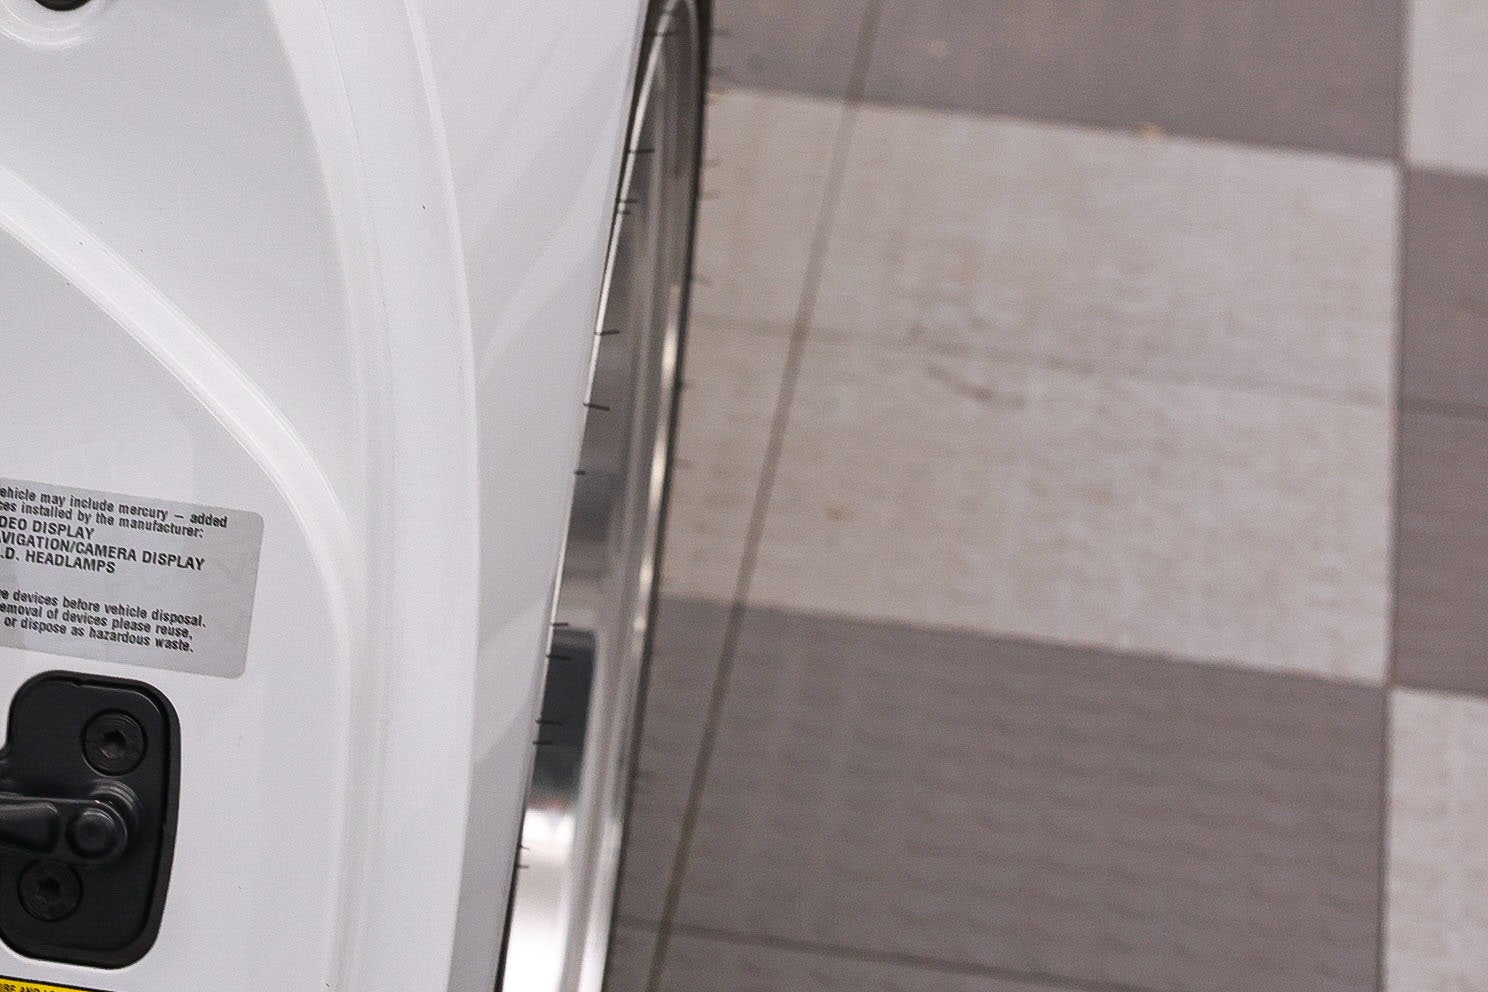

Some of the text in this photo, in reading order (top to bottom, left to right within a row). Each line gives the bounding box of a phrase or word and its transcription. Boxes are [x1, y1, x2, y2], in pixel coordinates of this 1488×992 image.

[21, 502, 72, 520] installed
[77, 509, 92, 524] by
[96, 512, 114, 526] the
[119, 517, 204, 538] manufacturer:
[40, 493, 66, 508] may
[70, 494, 114, 512] include
[119, 503, 168, 521] mercury
[190, 512, 228, 528] added
[33, 520, 94, 540] DISPLAY
[26, 549, 116, 573] HEADLAMPS
[142, 550, 205, 571] DISPLAY
[13, 589, 58, 606] devices
[63, 596, 100, 612] before
[104, 604, 147, 619] vehicle
[152, 608, 206, 627] disposal.
[47, 608, 59, 620] of
[62, 610, 107, 627] devices
[112, 617, 151, 633] please
[155, 624, 193, 640] reuse,
[4, 616, 17, 627] or
[21, 618, 67, 634] dispose
[71, 626, 85, 637] as
[89, 626, 151, 646] hazardous
[155, 638, 194, 653] waste.
